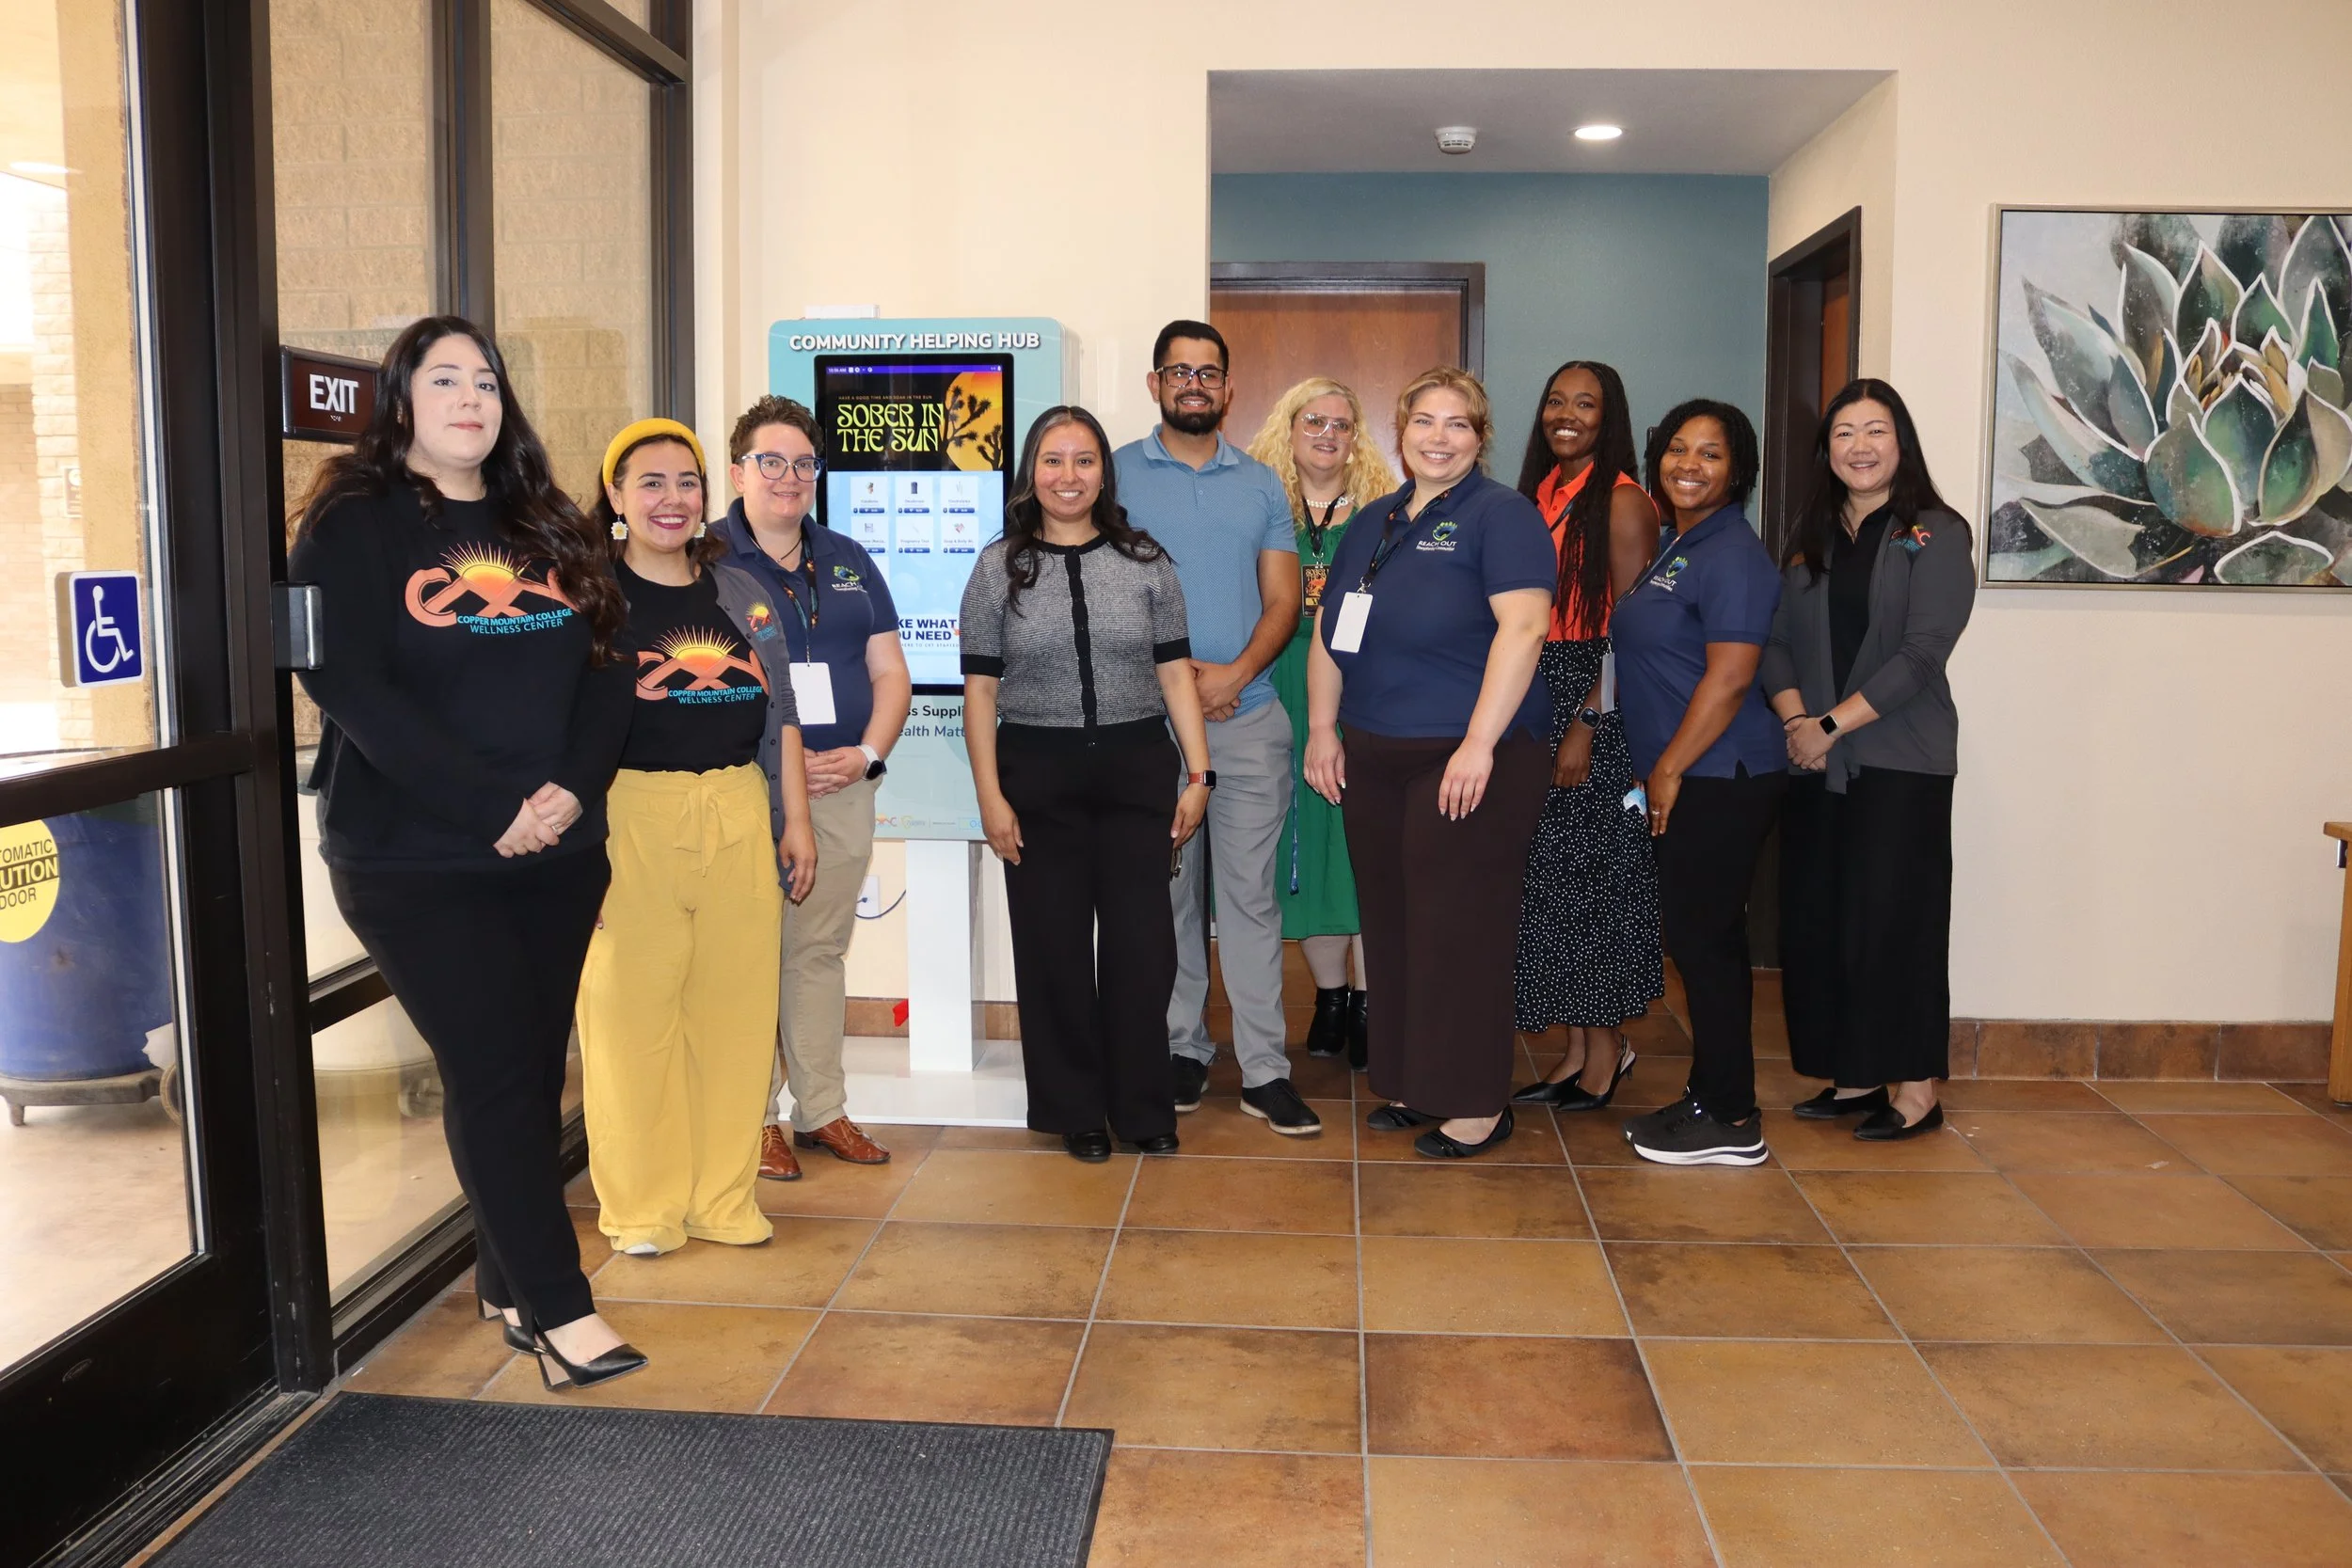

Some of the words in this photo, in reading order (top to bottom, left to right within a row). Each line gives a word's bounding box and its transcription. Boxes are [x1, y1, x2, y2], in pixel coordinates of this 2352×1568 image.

[788, 334, 906, 351] COMMUNITY
[910, 333, 993, 350] HELPING
[997, 332, 1041, 348] HUB
[310, 373, 359, 414] EXIT
[836, 404, 914, 427] SOBER
[921, 404, 944, 427] IN
[836, 428, 883, 451] THE
[891, 428, 938, 451] SUN
[457, 615, 489, 626] COPPER
[490, 614, 534, 626] MOUNTAIN
[535, 608, 573, 622] COLLEGE
[898, 619, 914, 628] KE
[916, 619, 957, 628] WHAT
[470, 624, 521, 634] WELLNESS
[523, 618, 564, 631] CENTER
[915, 631, 951, 640] NEED
[678, 695, 723, 705] WELLNESS
[724, 693, 755, 703] CENTER
[696, 688, 735, 698] MOUNTAIN
[923, 705, 964, 719] Suppli
[934, 725, 966, 736] Matt
[0, 839, 53, 863] OMATIC
[0, 856, 58, 891] UTION
